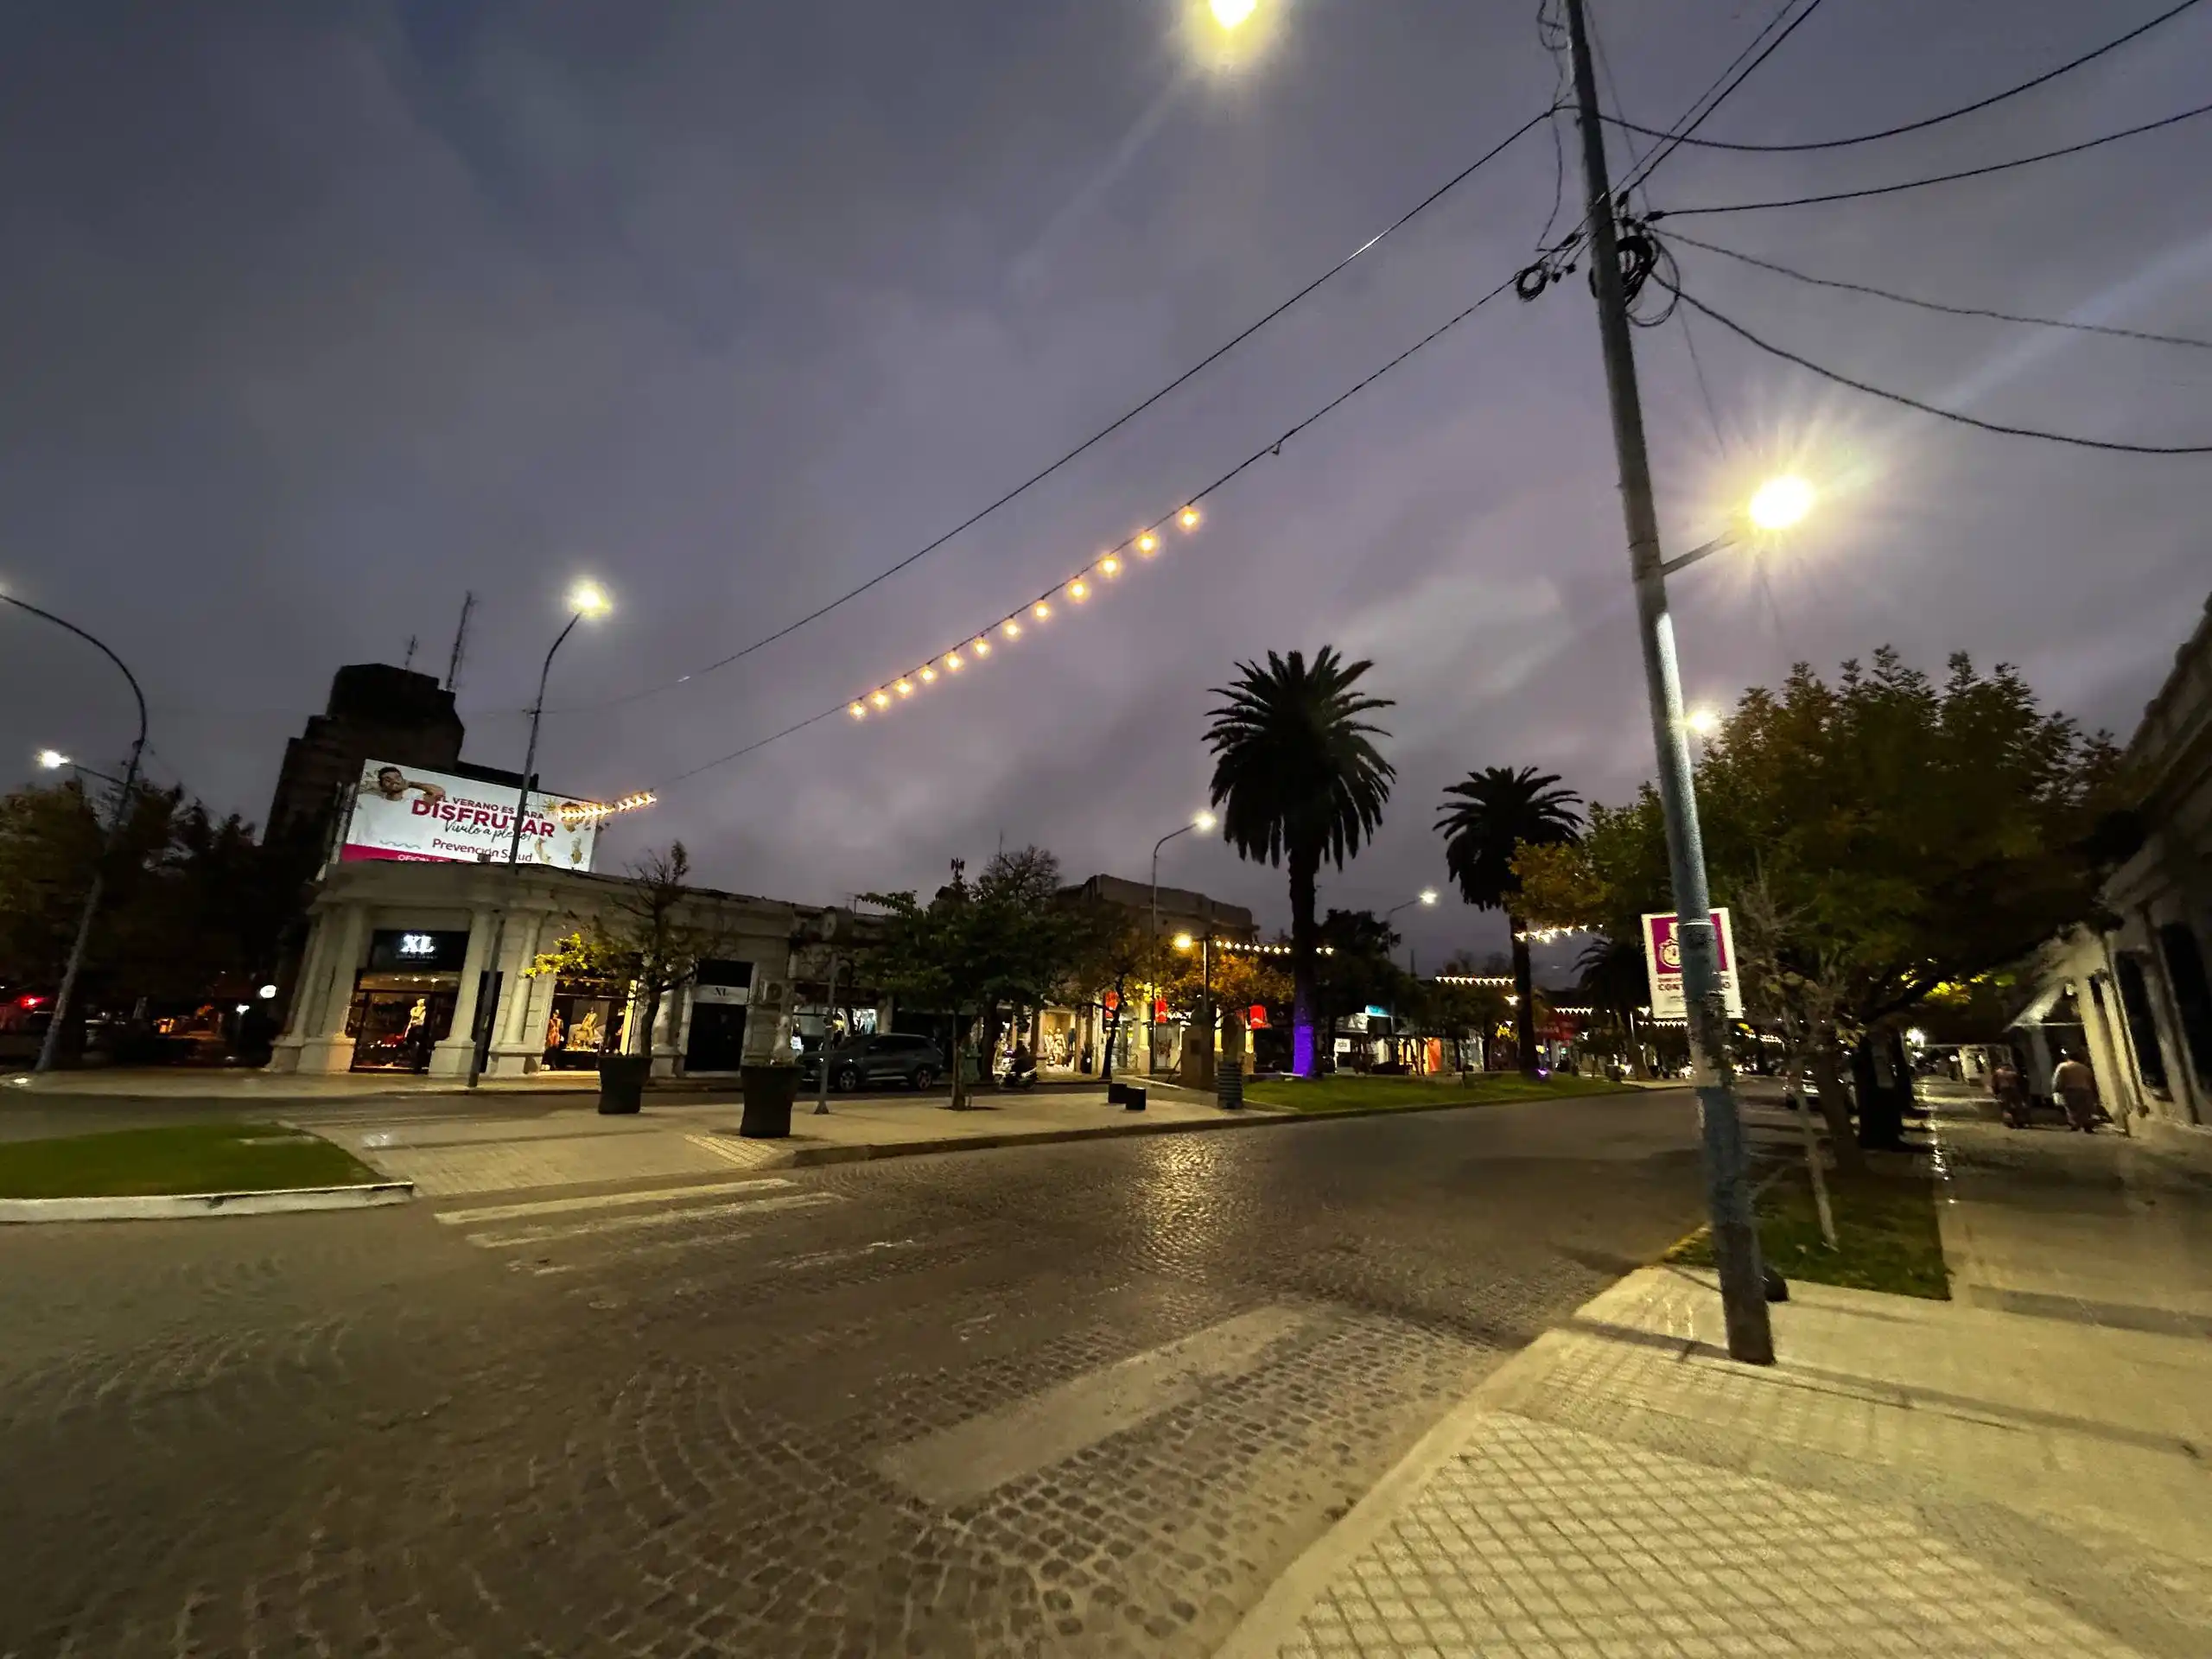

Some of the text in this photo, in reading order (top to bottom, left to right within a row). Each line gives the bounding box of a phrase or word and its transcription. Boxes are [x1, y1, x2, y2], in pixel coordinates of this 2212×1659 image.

[453, 796, 499, 811] VERANO
[501, 805, 514, 814] ES
[491, 824, 532, 843] pleo!
[400, 935, 435, 953] XL
